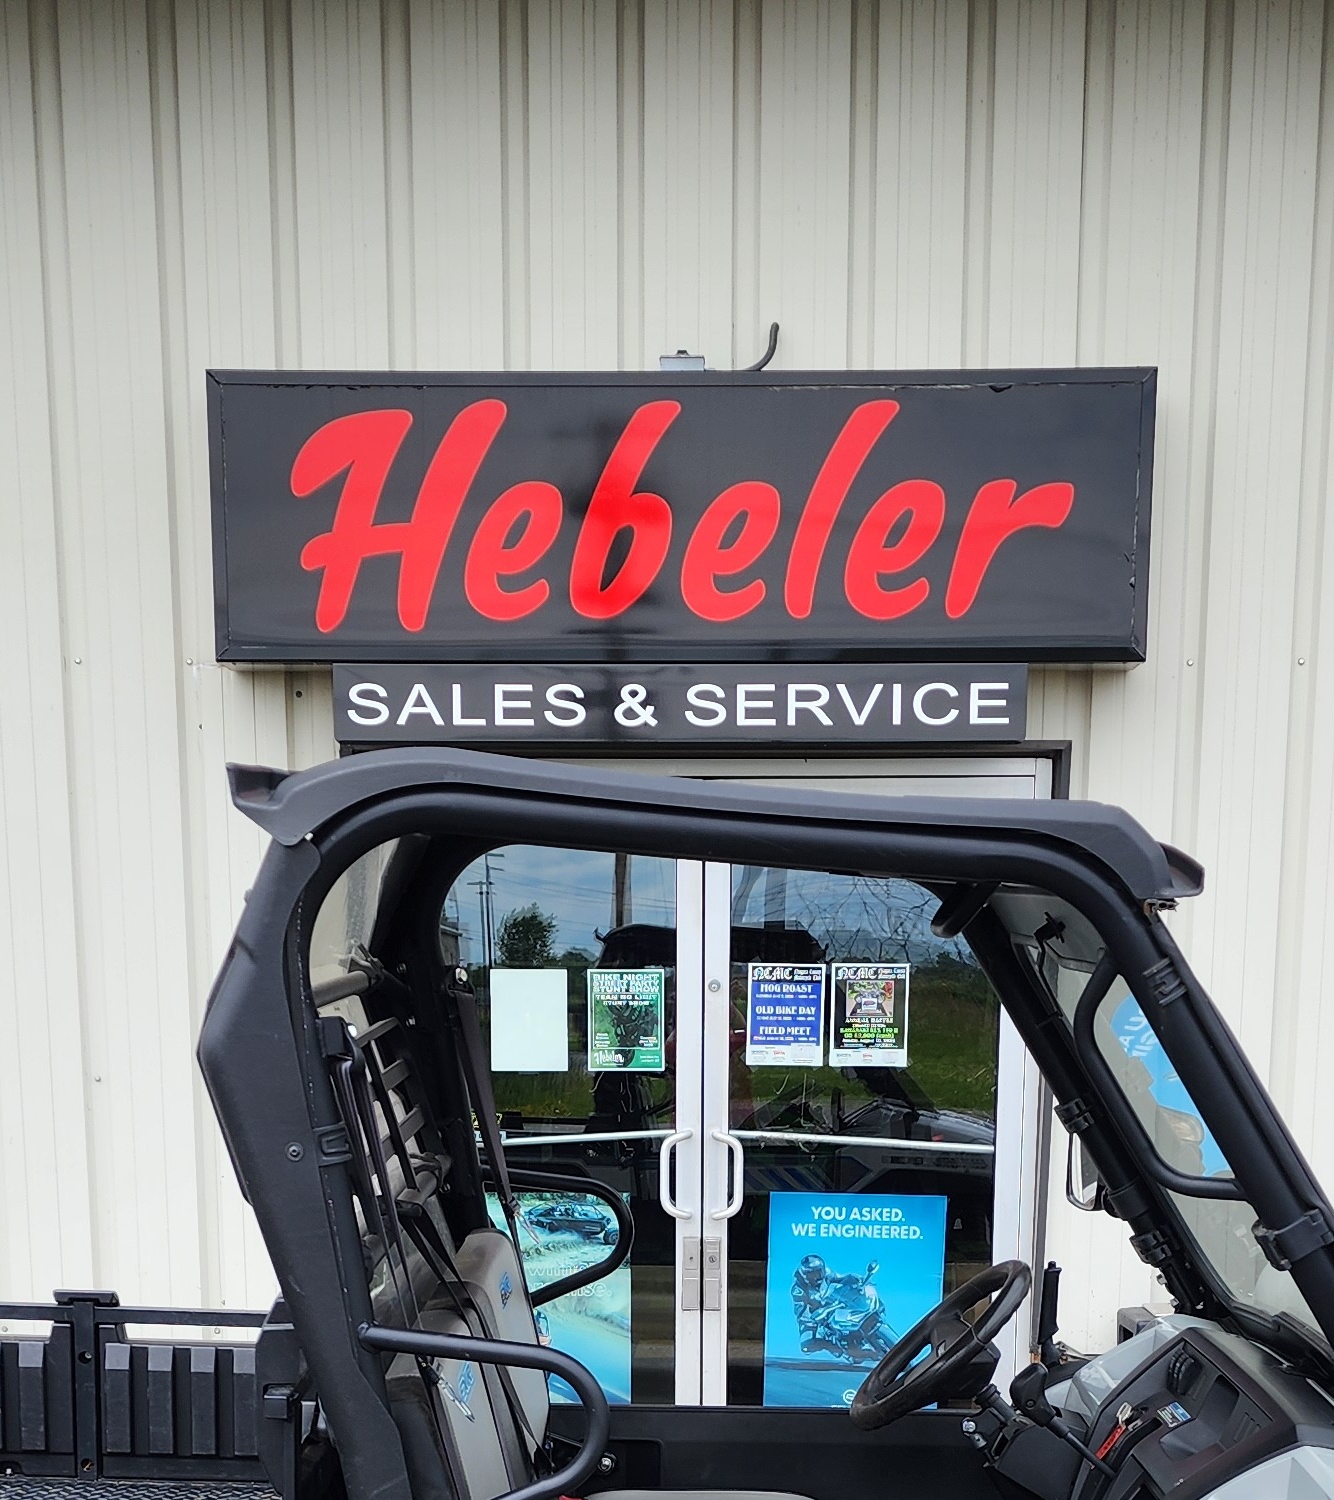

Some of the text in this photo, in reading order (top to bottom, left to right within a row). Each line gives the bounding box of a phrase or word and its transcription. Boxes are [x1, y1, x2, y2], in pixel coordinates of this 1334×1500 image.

[289, 398, 1074, 634] Hebeler
[346, 681, 1011, 728] SALES & SERVICE
[799, 1006, 816, 1015] DAY
[811, 1206, 906, 1222] YOU ASKED.
[791, 1222, 924, 1240] WE ENGINEERED.
